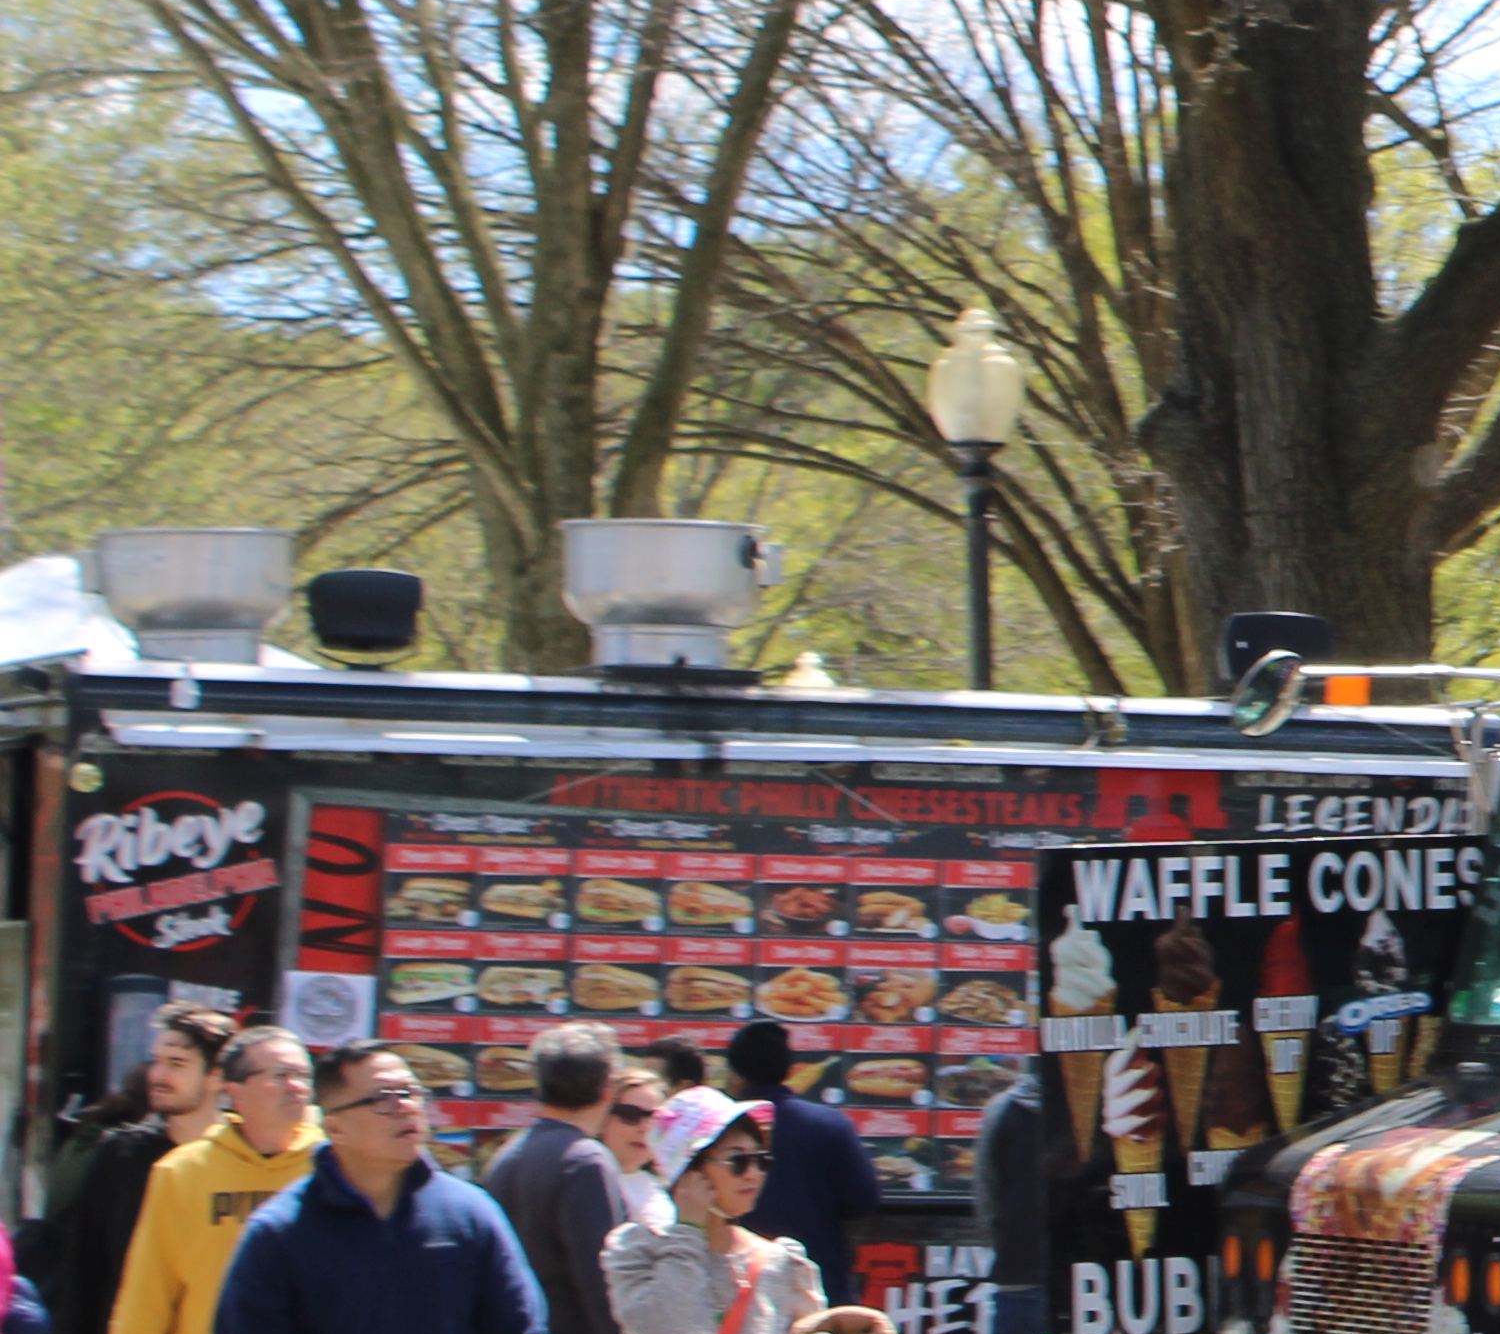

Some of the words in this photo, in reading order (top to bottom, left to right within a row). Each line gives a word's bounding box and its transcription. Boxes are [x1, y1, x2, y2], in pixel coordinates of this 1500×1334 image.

[73, 801, 265, 884] Ribeye
[1073, 854, 1290, 922] WAFFLE
[1308, 847, 1485, 914] CONES
